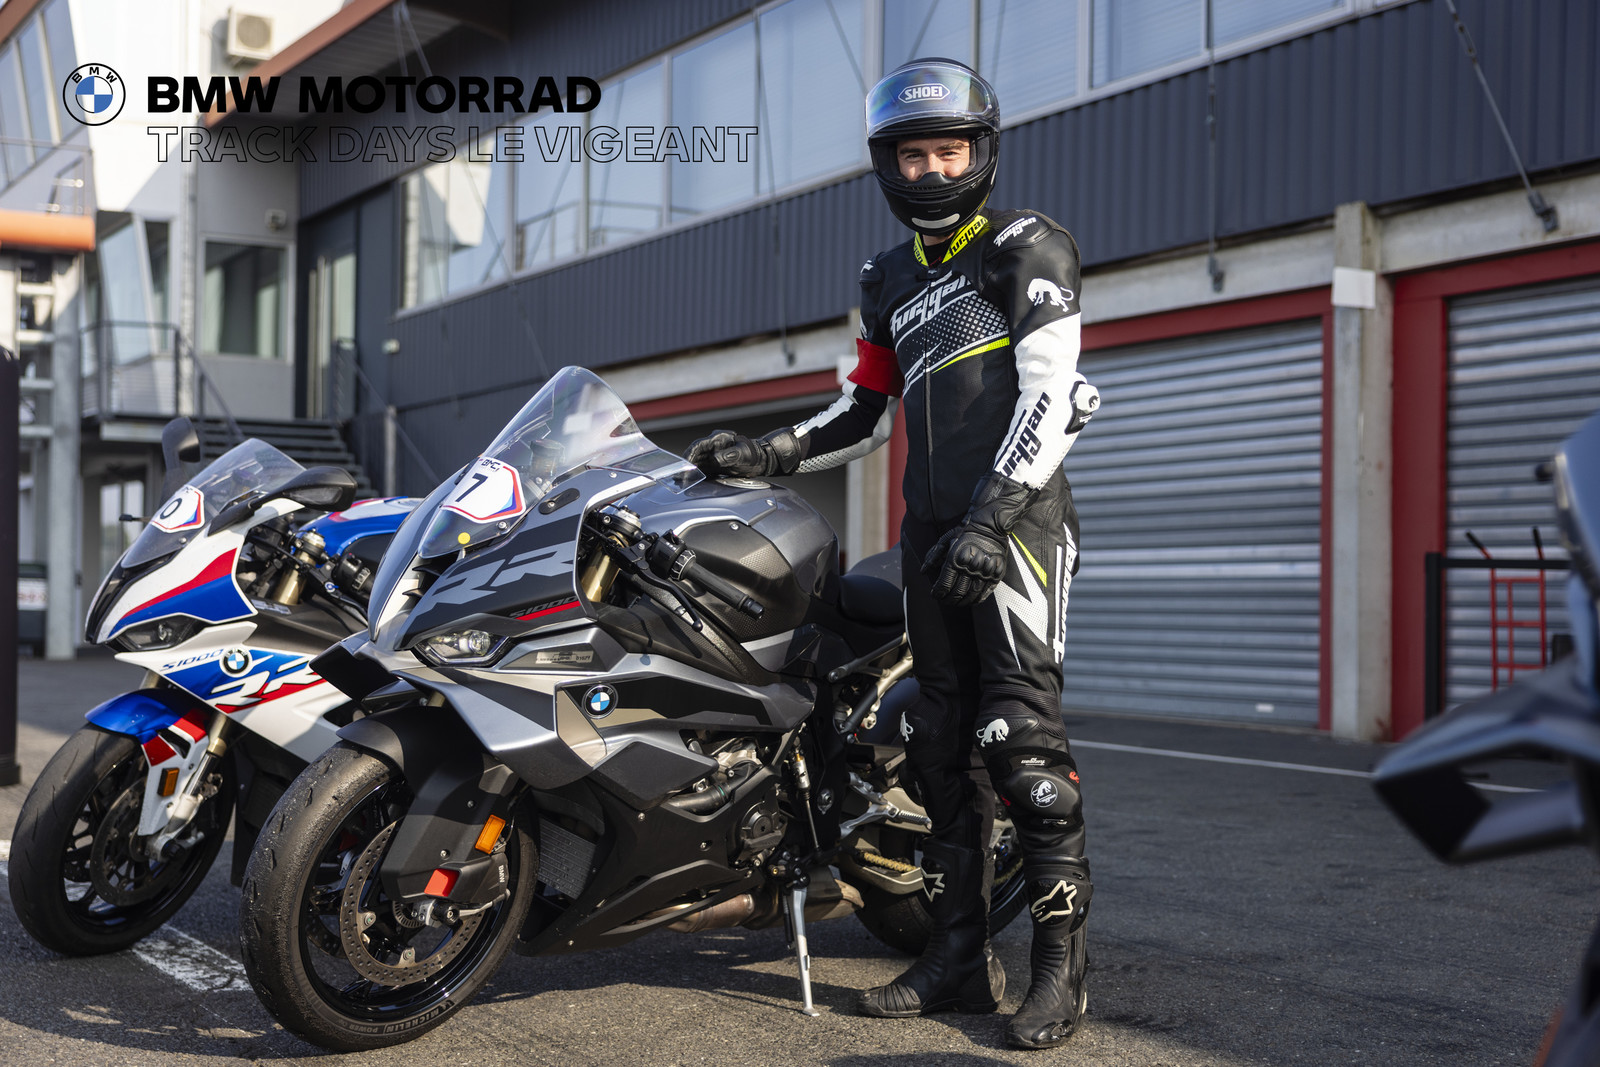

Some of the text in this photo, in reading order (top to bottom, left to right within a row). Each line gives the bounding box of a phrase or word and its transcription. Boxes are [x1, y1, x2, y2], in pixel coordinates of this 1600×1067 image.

[904, 86, 943, 101] SHOEI
[455, 473, 488, 502] 7
[160, 649, 224, 671] S1000
[348, 1022, 379, 1034] POWER
[386, 1008, 440, 1034] MICHELIN
